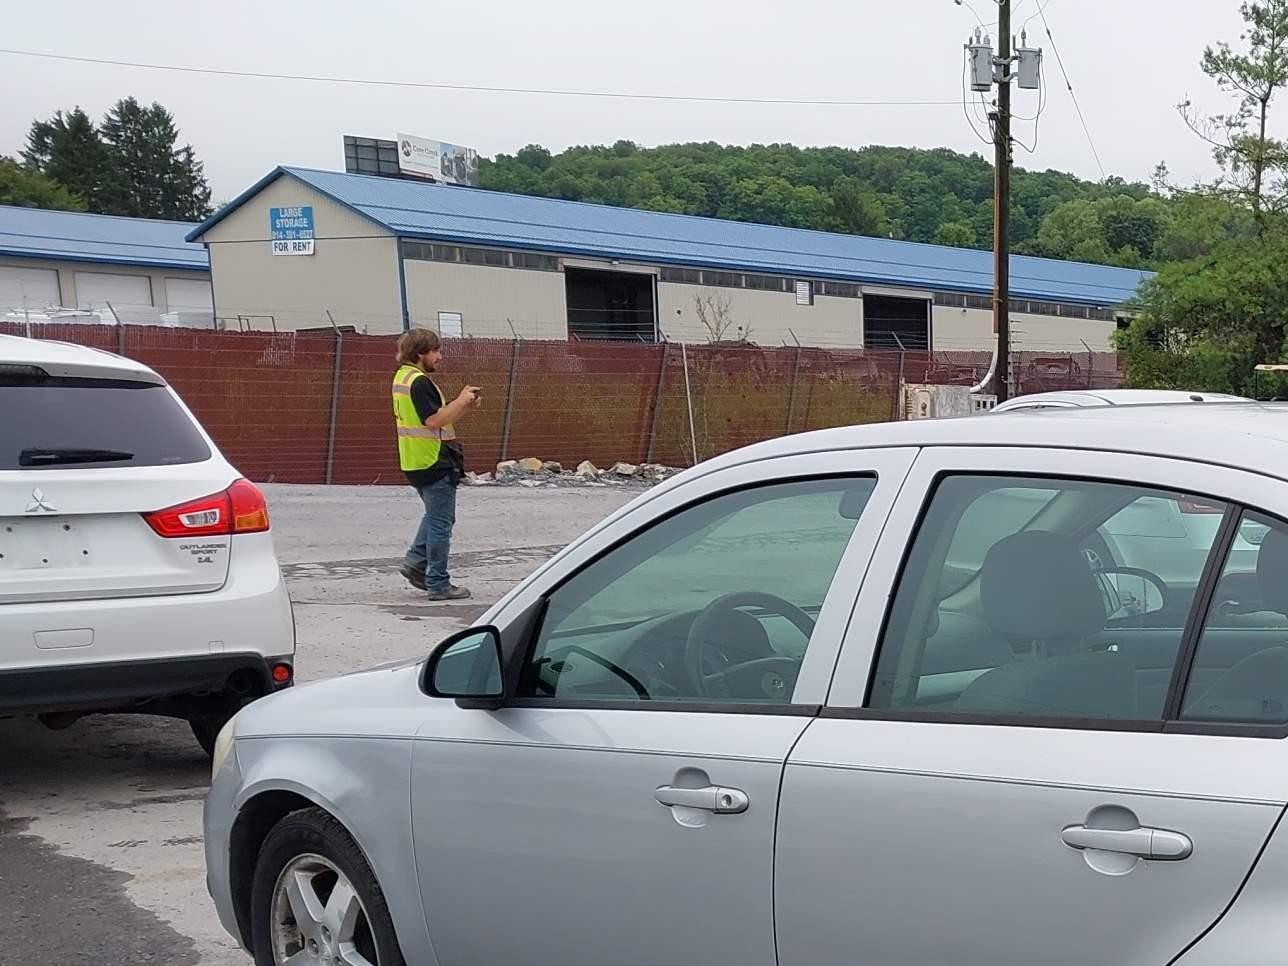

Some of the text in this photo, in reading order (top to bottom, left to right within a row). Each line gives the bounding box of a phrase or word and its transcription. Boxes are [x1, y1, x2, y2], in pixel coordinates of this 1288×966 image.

[280, 207, 303, 217] LARGE
[276, 217, 309, 228] STORAGE
[273, 241, 312, 252] FOR RENT
